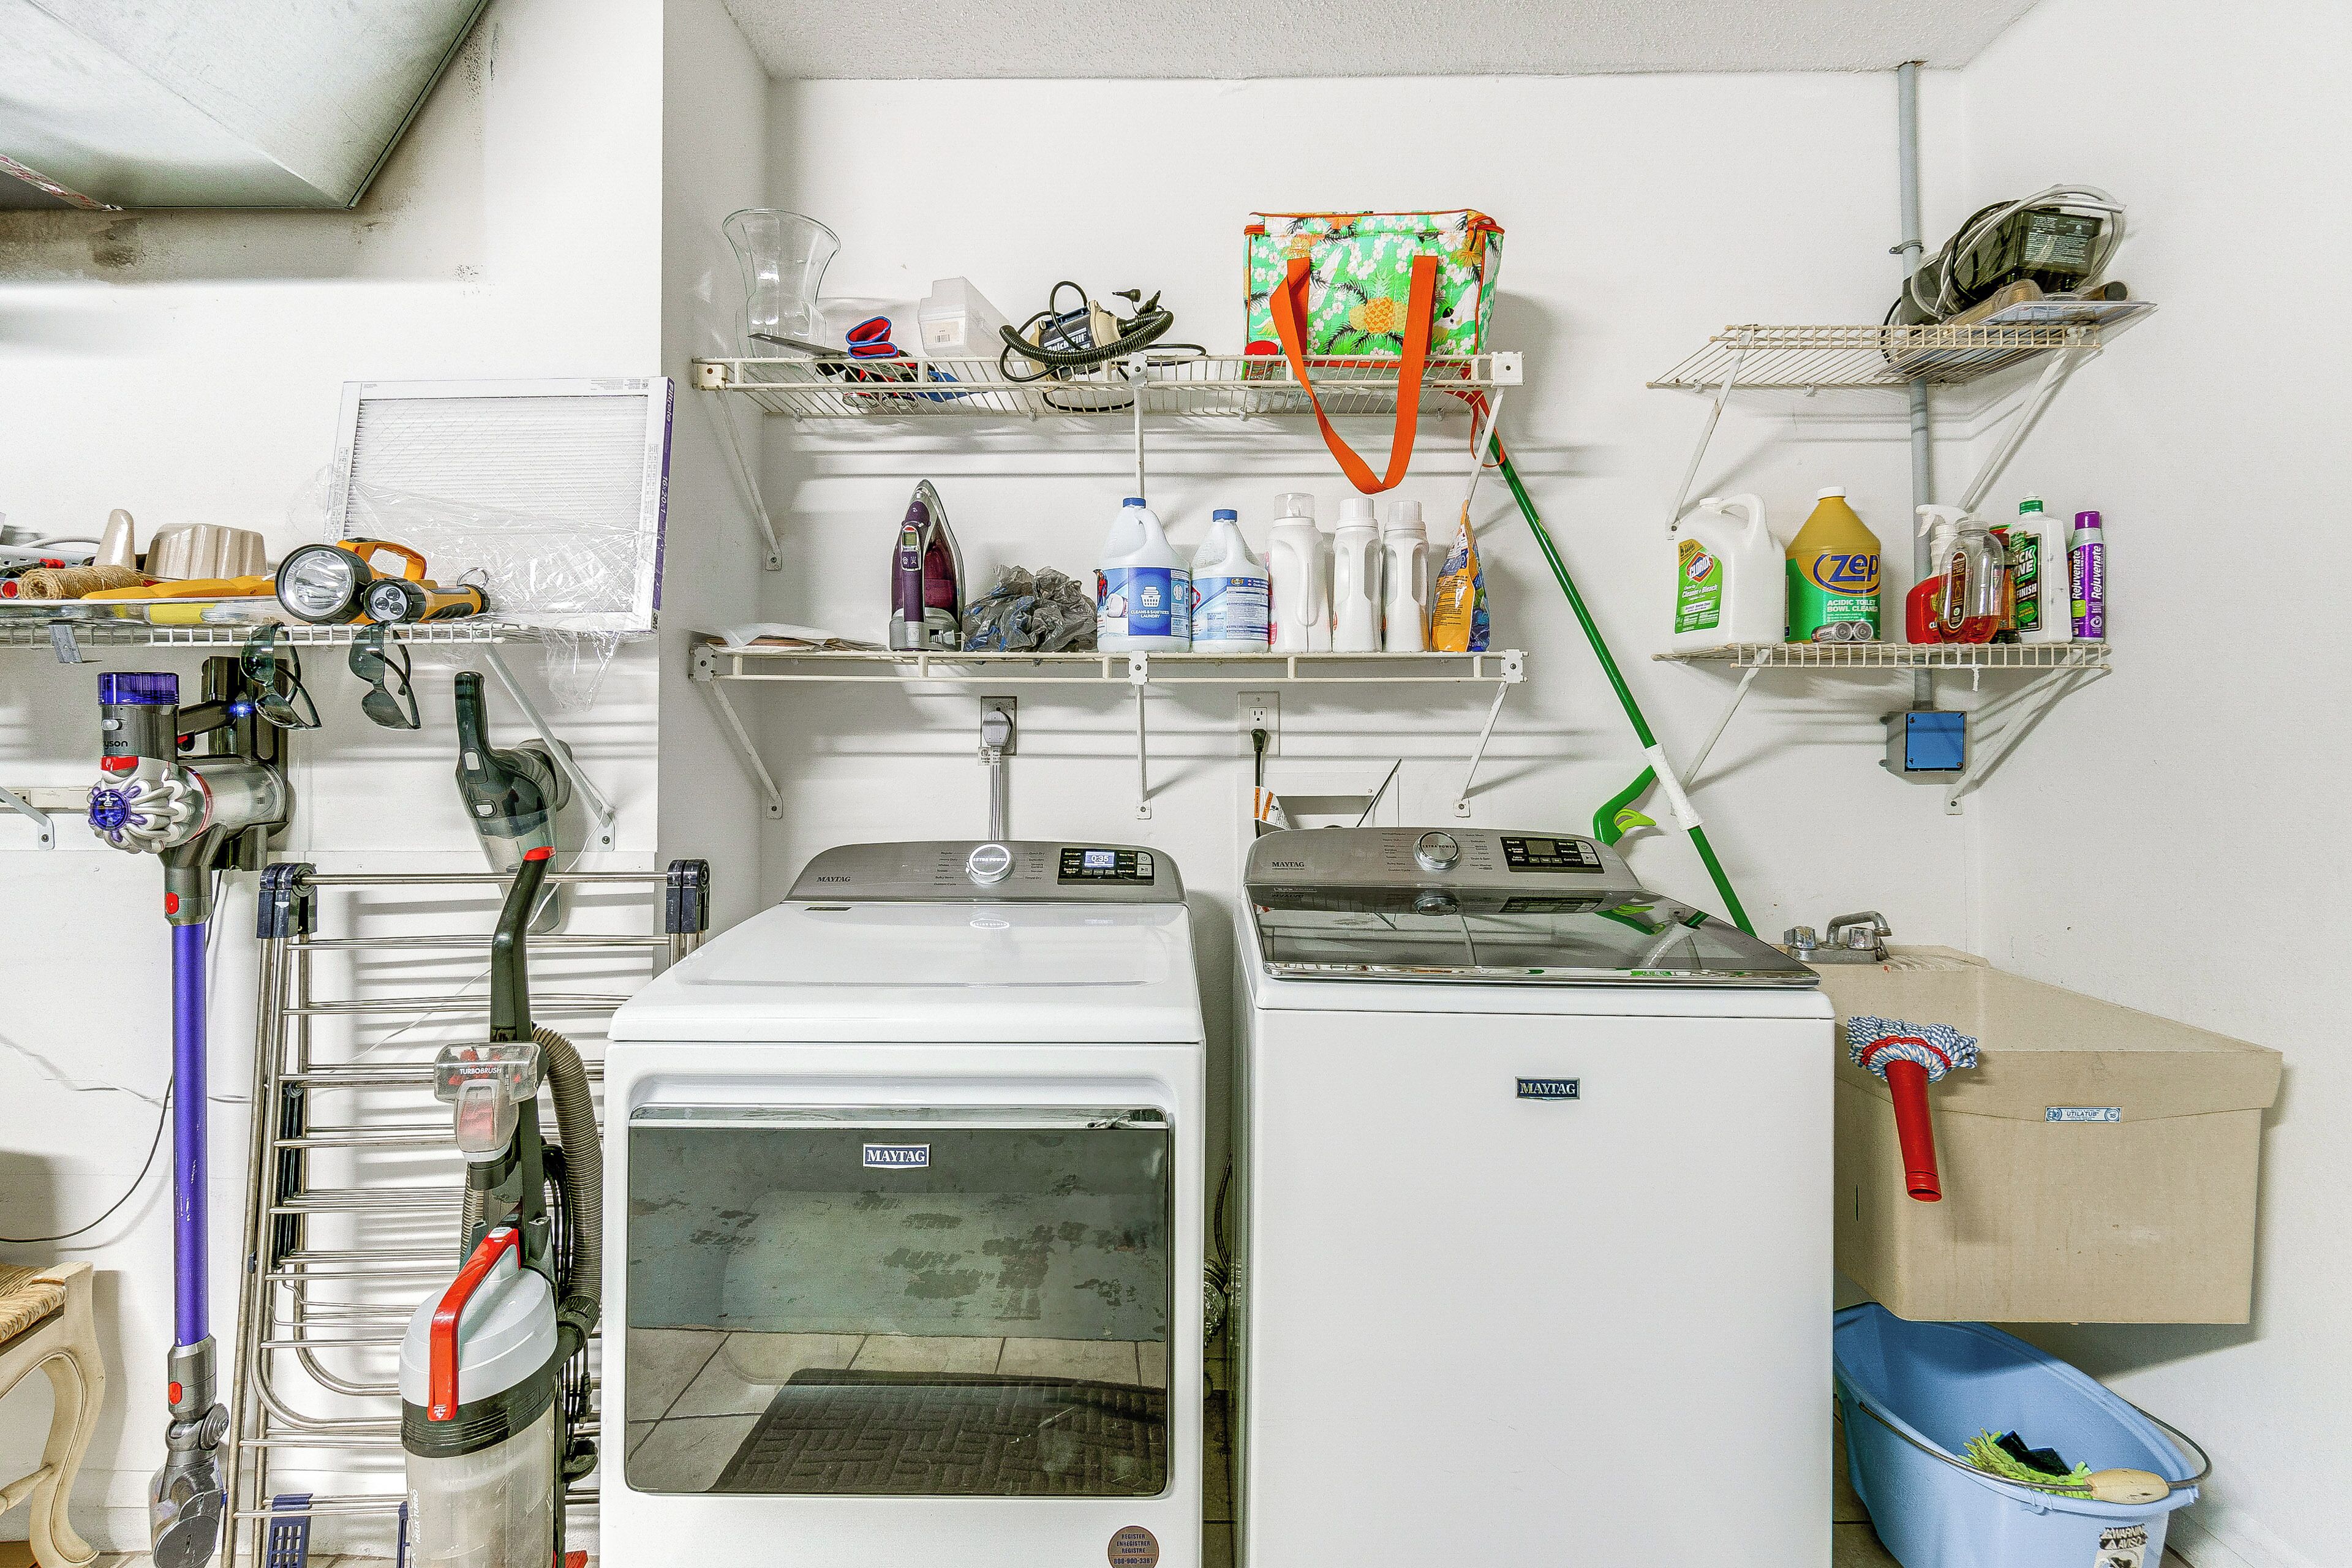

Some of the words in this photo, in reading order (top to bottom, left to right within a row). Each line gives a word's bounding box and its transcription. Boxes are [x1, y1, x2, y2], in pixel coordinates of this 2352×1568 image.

[1689, 554, 1711, 579] CLOROX
[2090, 545, 2102, 600] Rejuvenate
[2072, 549, 2082, 600] Rejuvenate
[2016, 583, 2037, 599] FINISH
[104, 740, 128, 750] yson
[1519, 1082, 1576, 1095] MAYTAG
[866, 1149, 925, 1163] MAYTAG
[2111, 1525, 2145, 1539] WARNIN
